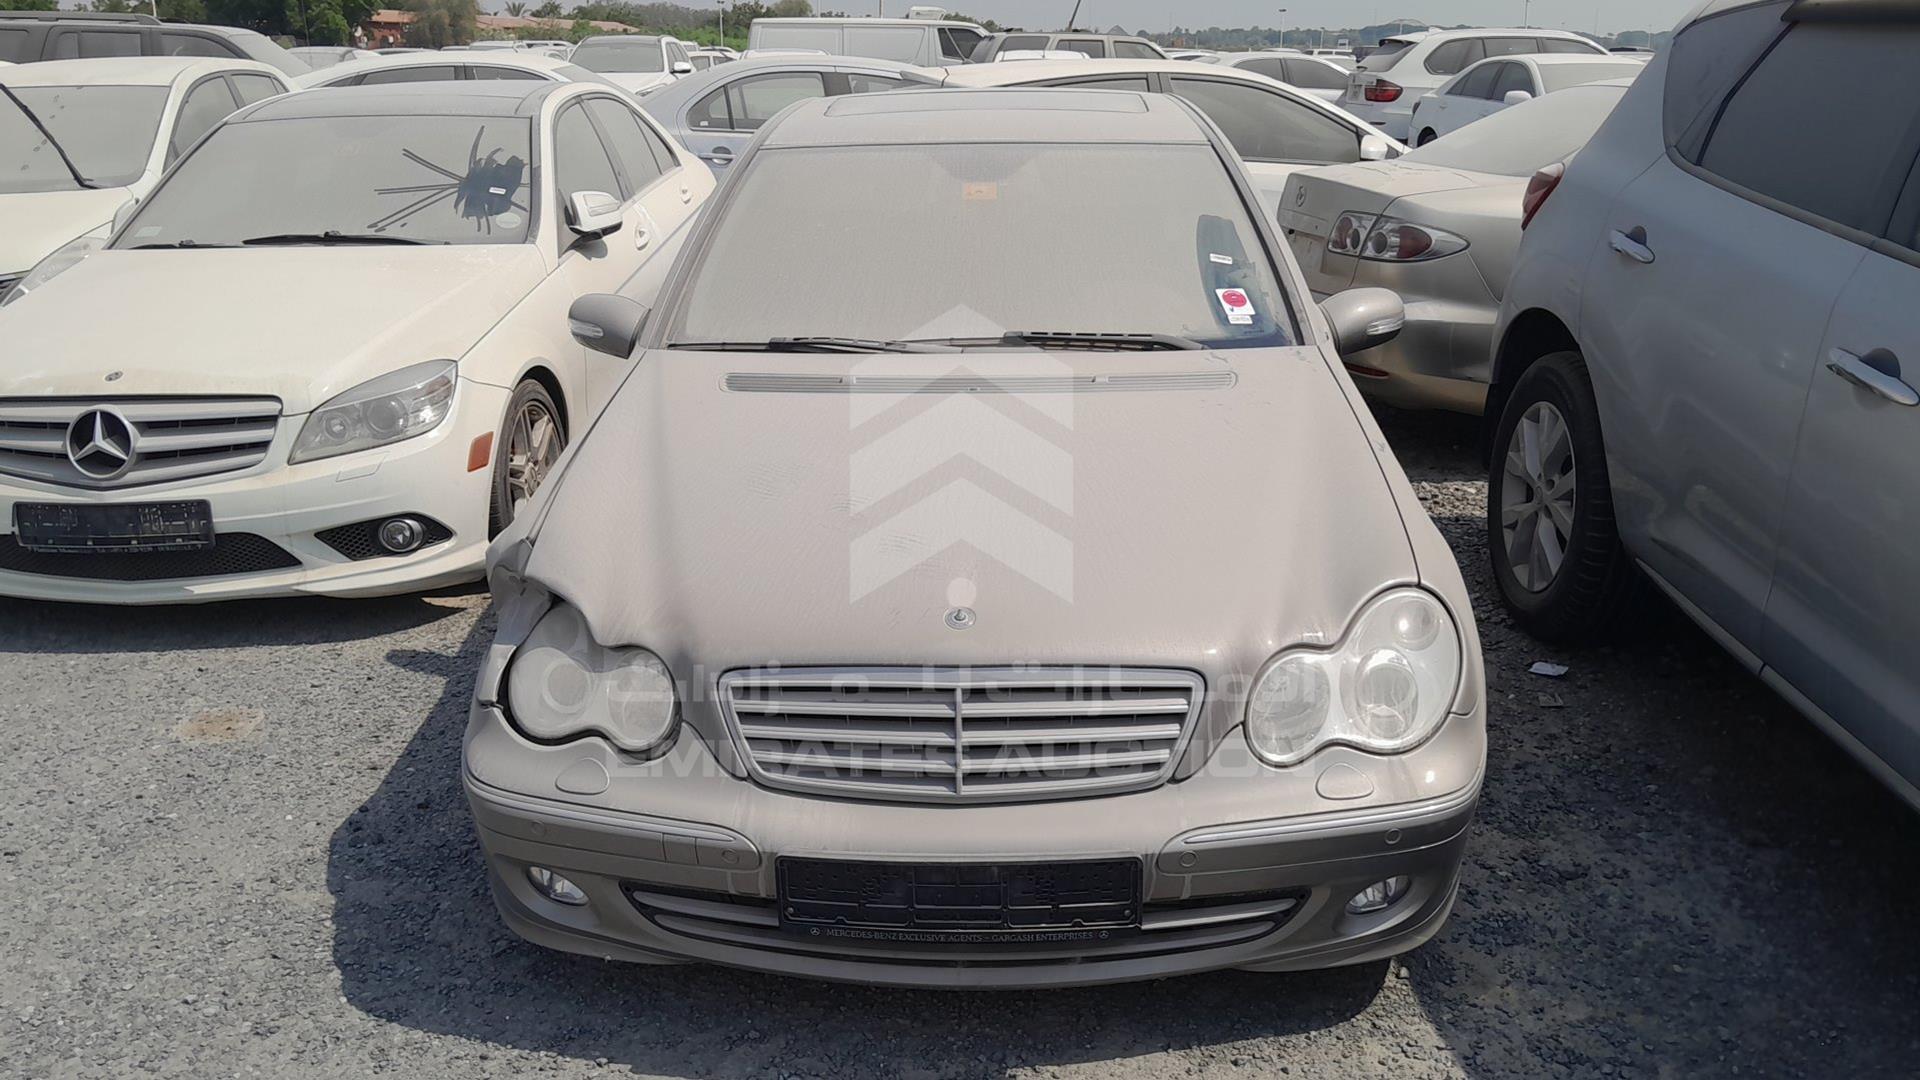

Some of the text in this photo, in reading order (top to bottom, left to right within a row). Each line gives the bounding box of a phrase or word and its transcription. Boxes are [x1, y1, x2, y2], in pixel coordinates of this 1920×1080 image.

[826, 928, 896, 941] MERCEDES-BENZ
[899, 932, 946, 942] EXCLUSIVE
[949, 933, 983, 942] AGENTS
[1036, 930, 1094, 941] ENTERPRISES
